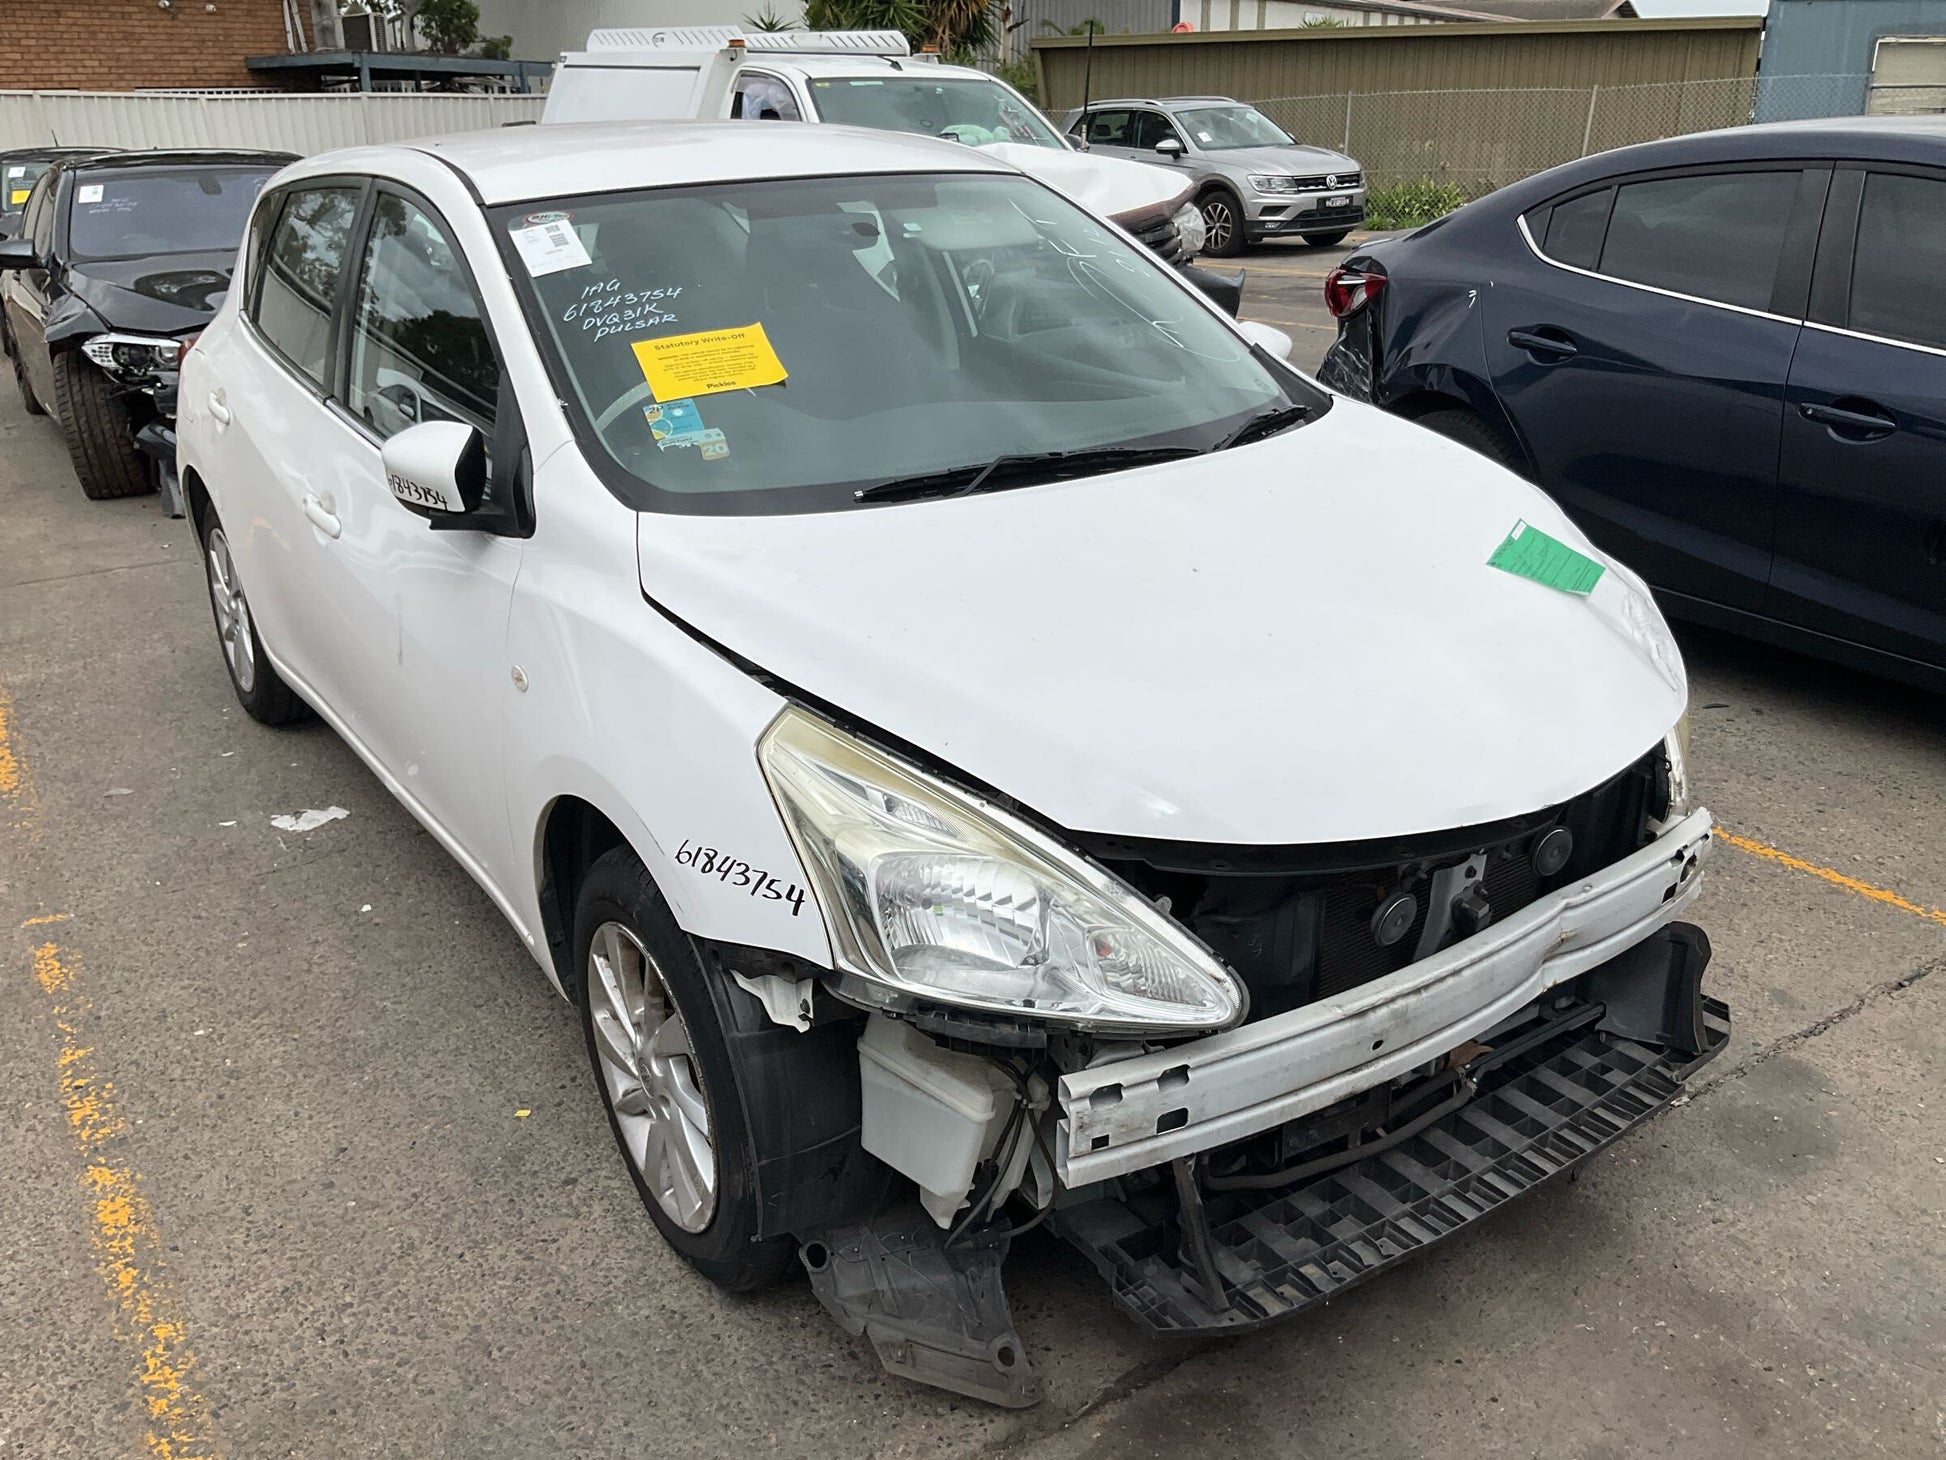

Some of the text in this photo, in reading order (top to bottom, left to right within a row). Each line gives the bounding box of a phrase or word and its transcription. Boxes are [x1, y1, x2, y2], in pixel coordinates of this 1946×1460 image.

[563, 287, 683, 322] 61843754
[593, 313, 678, 343] PULSAR
[654, 332, 745, 351] Statutory Write-Off
[706, 380, 737, 389] Pickles
[704, 443, 729, 456] 20
[674, 839, 806, 917] 61843754
